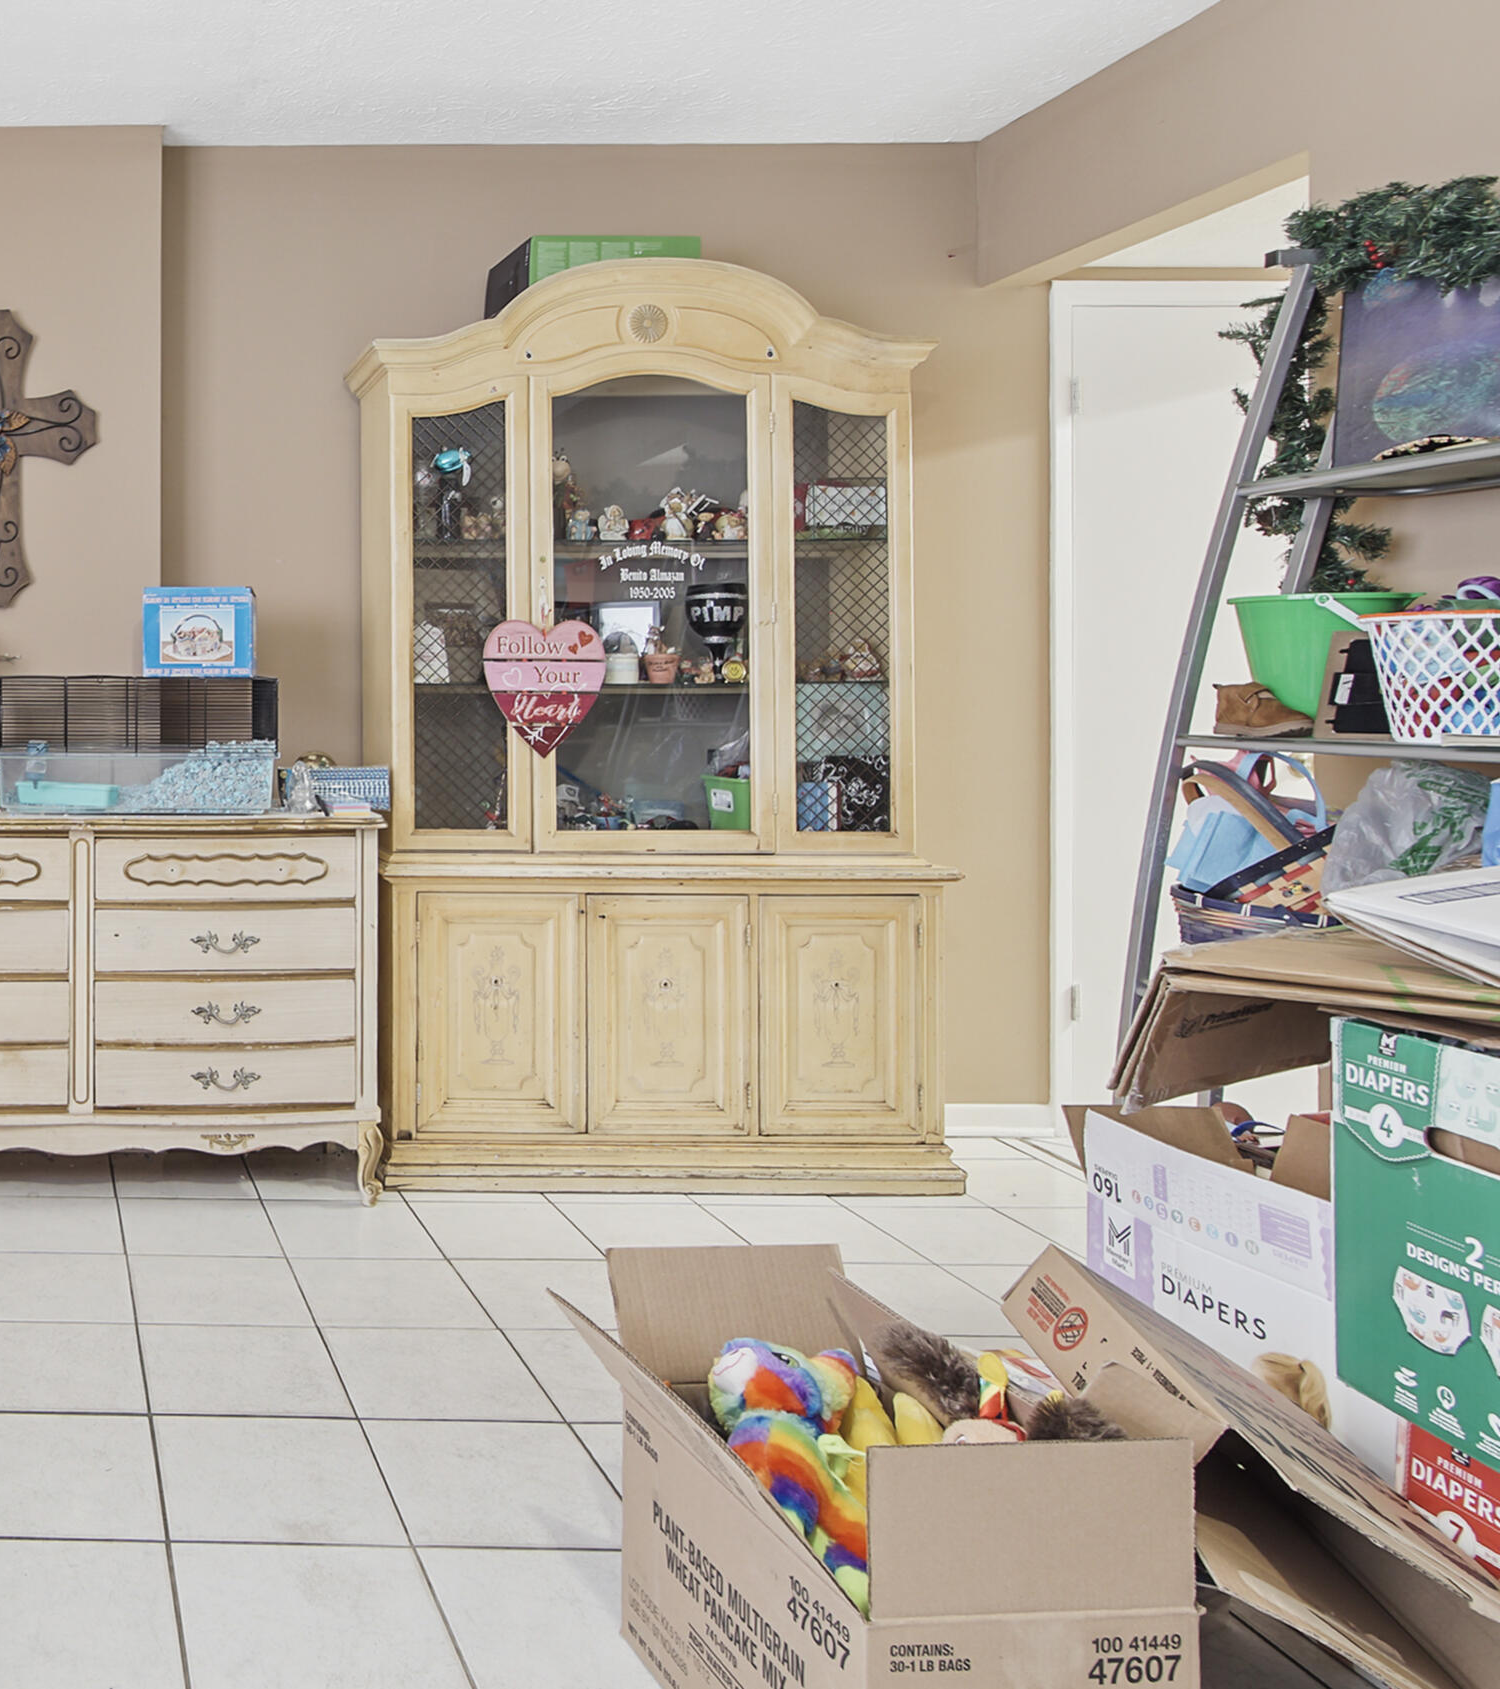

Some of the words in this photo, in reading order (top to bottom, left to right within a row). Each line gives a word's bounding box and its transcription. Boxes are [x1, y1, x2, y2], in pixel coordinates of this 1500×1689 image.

[599, 556, 614, 571] In
[614, 543, 647, 562] Loving
[649, 541, 689, 564] Memory
[629, 587, 676, 599] 1950-2005
[691, 604, 745, 623] PIMP
[497, 635, 565, 655] Follow
[534, 666, 581, 684] Your
[510, 695, 582, 721] Heart
[1367, 1054, 1408, 1075] PREMIUM
[1345, 1062, 1430, 1106] DIAPERS
[1379, 1113, 1393, 1138] 4
[1406, 1242, 1470, 1282] DESIGNS
[1464, 1236, 1484, 1270] 2
[1161, 1262, 1213, 1295] PREMIUM
[1161, 1274, 1268, 1341] DIAPERS
[1437, 1456, 1483, 1489] PREMIUM
[1449, 1520, 1464, 1545] 7
[653, 1500, 724, 1597] PLANT-BASED
[728, 1583, 805, 1688] MULTIGRAIN
[666, 1544, 700, 1603] WHEAT
[704, 1588, 758, 1671] PANCAKE
[789, 1575, 809, 1603] 100
[813, 1600, 850, 1642] 41449
[787, 1597, 850, 1670] 47607
[1092, 1637, 1122, 1653] 100
[1129, 1634, 1182, 1651] 41449
[890, 1643, 954, 1657] CONTAINS:
[890, 1660, 916, 1673] 30-1
[919, 1660, 934, 1672] LB
[938, 1658, 971, 1672] BAGS
[1088, 1655, 1182, 1685] 47607
